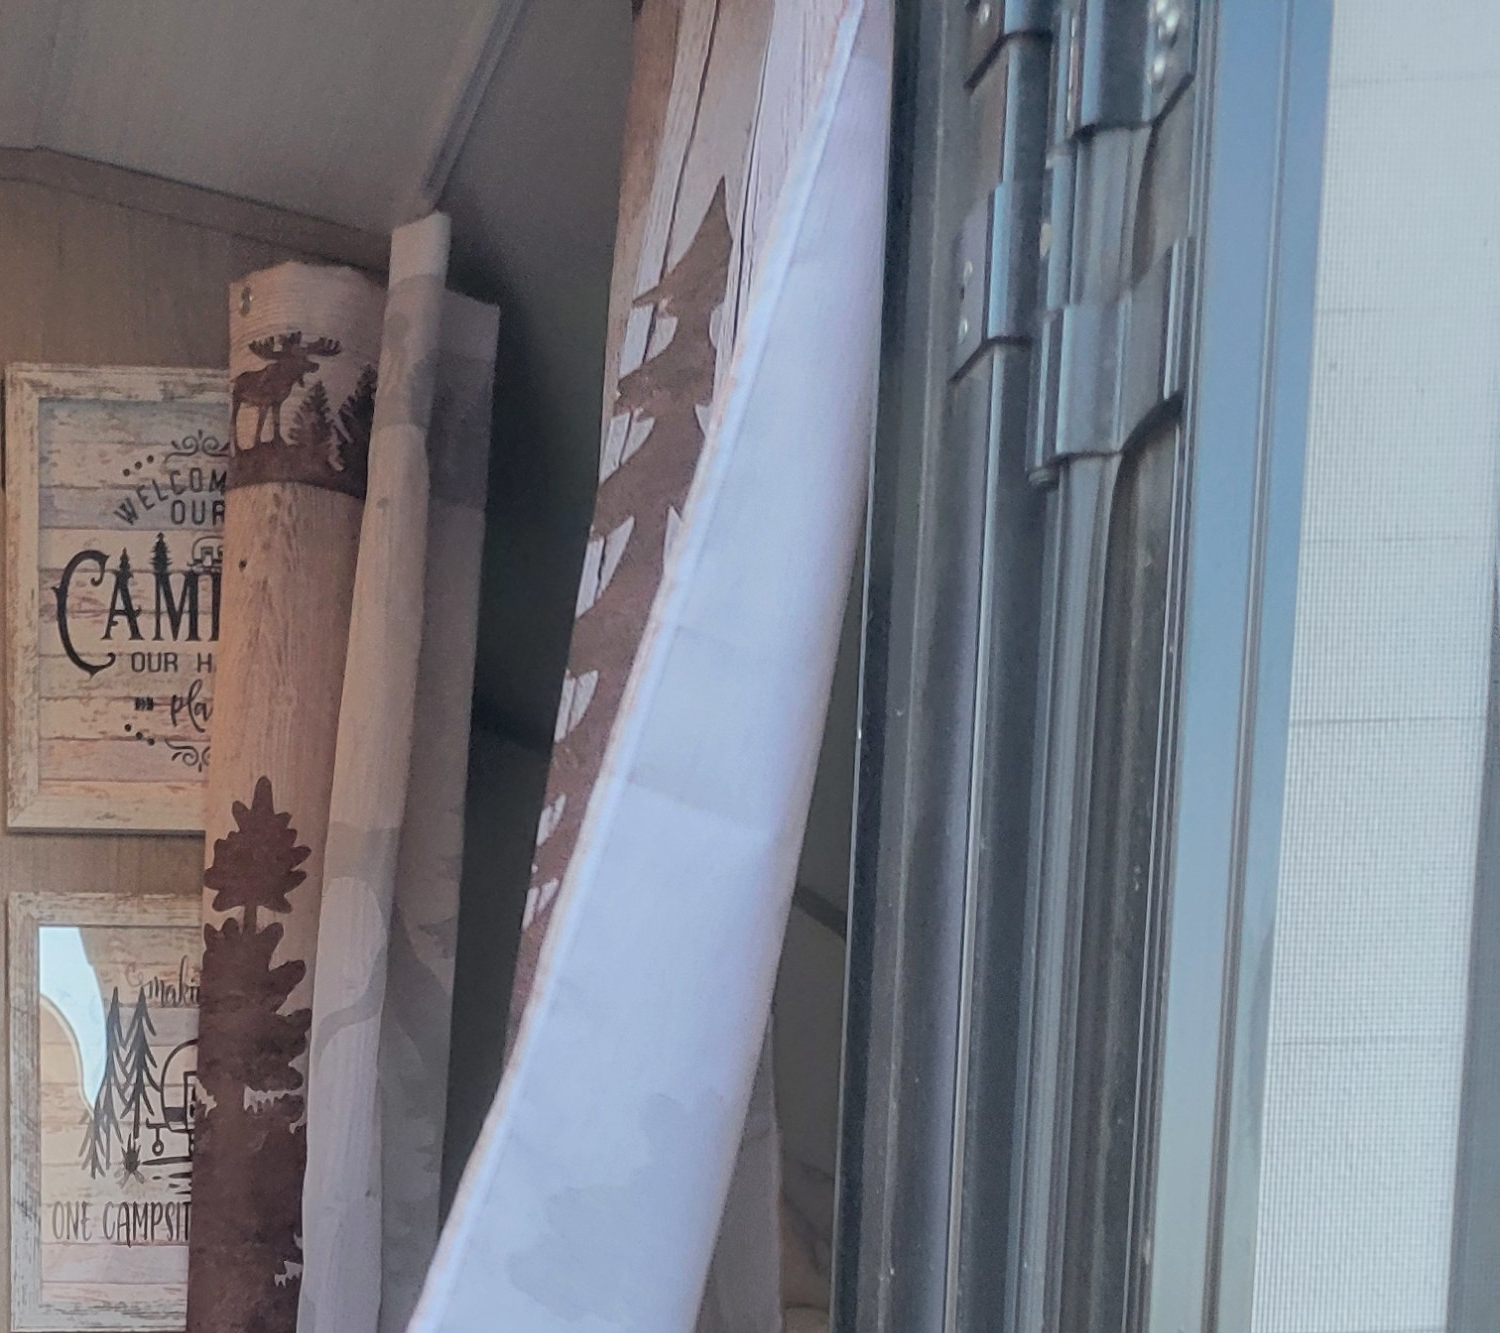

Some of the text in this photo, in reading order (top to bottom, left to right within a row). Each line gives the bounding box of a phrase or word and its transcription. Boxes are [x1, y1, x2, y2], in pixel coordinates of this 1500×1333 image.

[113, 467, 227, 526] WELCOM
[171, 499, 225, 526] OUR
[131, 651, 178, 673] OUR
[171, 678, 214, 733] pla
[52, 1201, 191, 1247] ONE CAMPSIT
